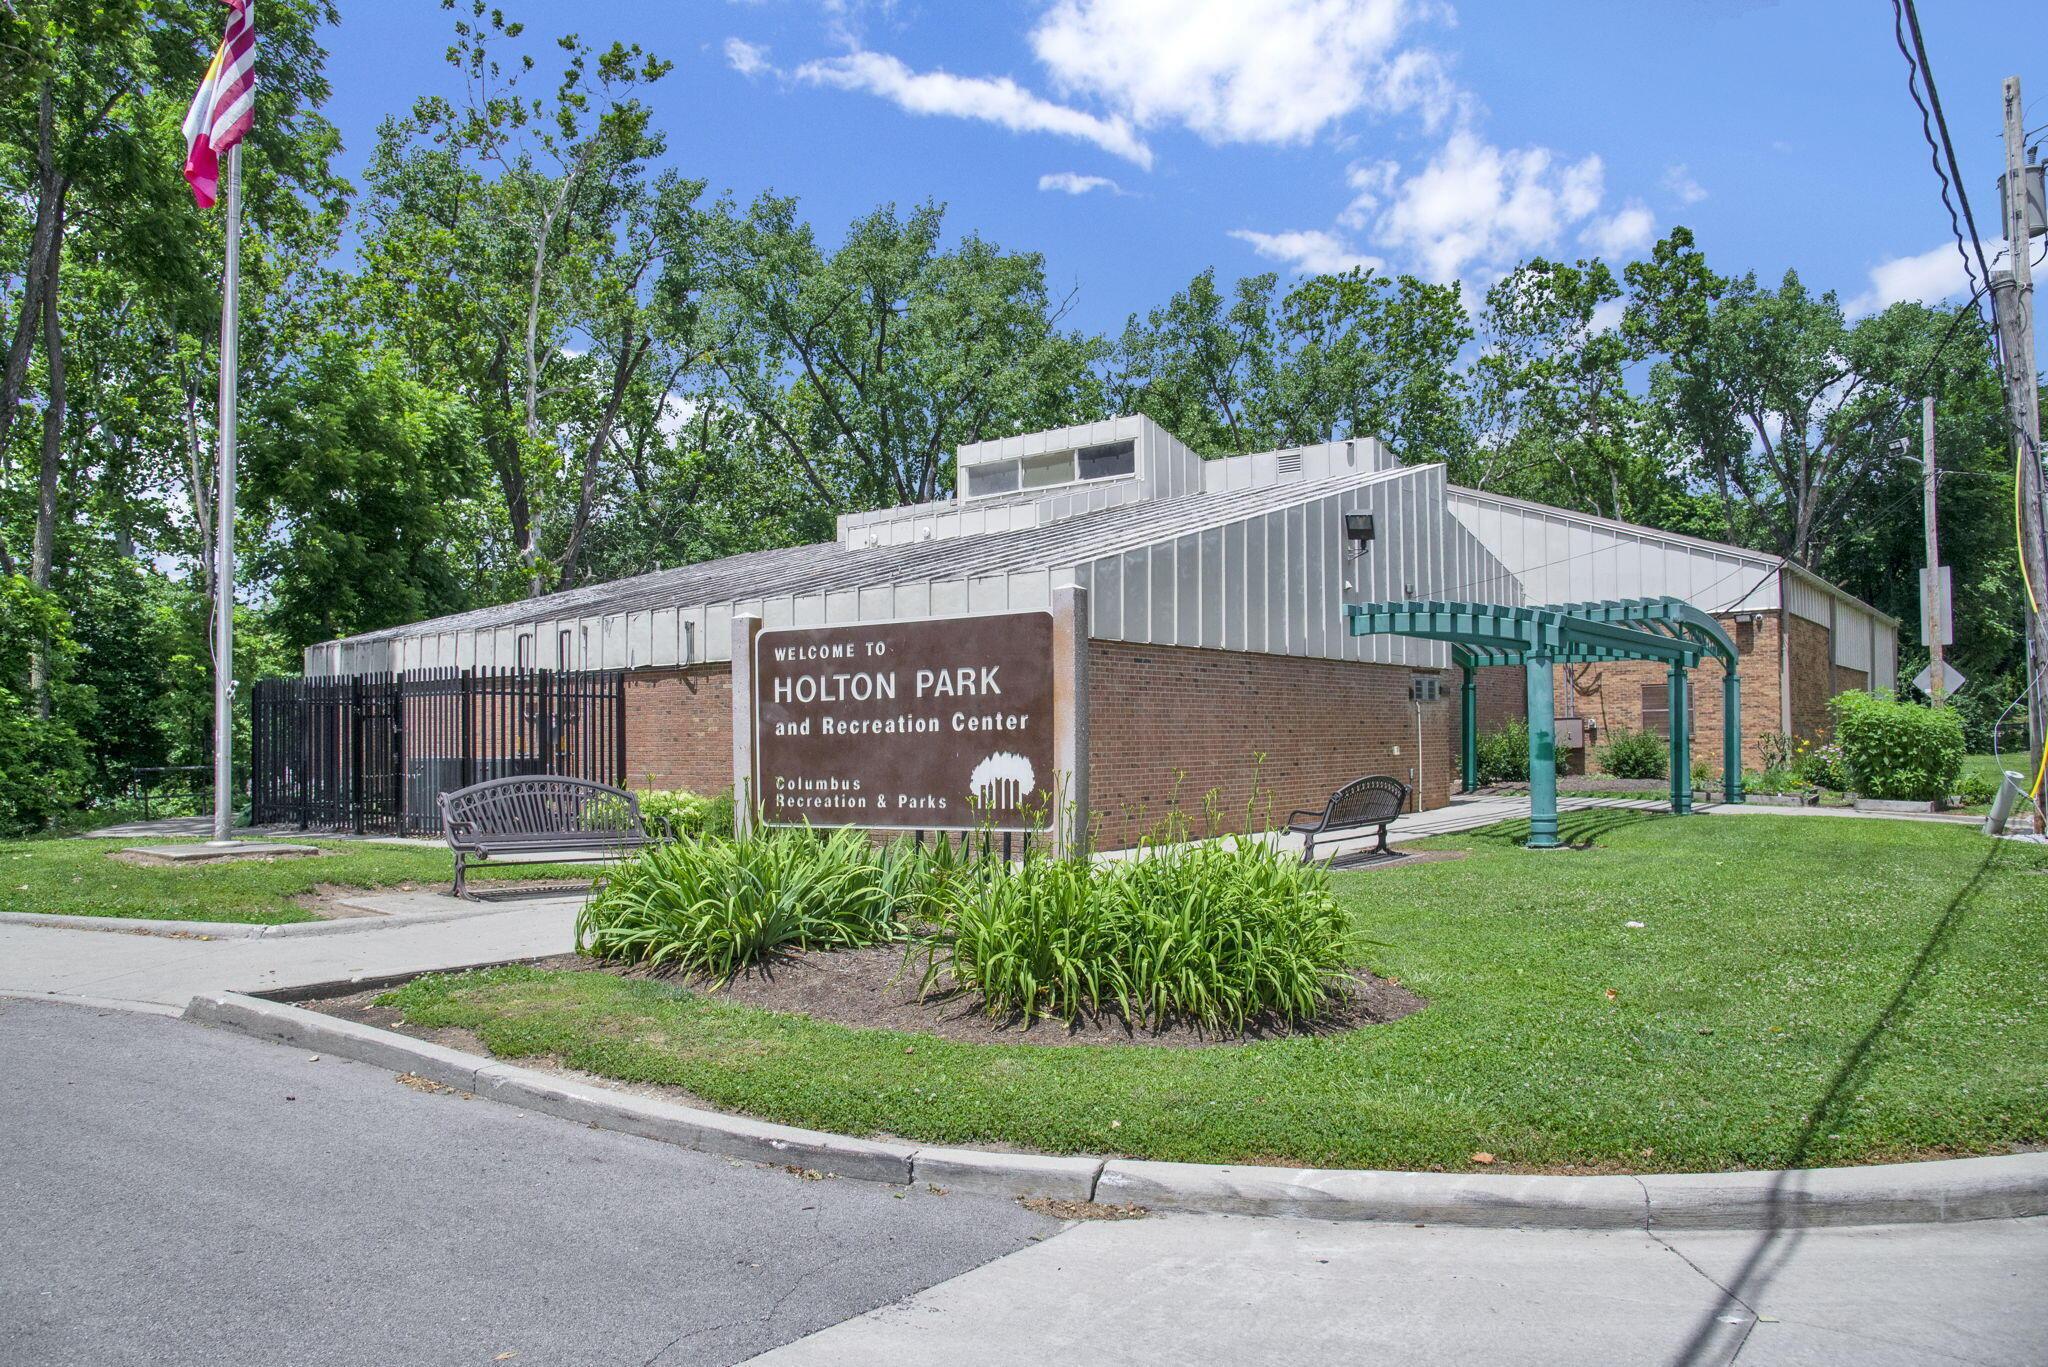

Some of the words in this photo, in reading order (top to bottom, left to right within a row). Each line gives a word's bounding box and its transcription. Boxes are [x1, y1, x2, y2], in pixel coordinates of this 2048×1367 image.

[774, 643, 855, 662] WELCOME
[866, 641, 886, 656] TO
[774, 671, 896, 703] HOLTON
[916, 665, 1001, 698] PARK
[775, 717, 810, 736] and
[822, 713, 940, 735] Recreation
[952, 711, 1029, 732] Center
[775, 776, 861, 791] Columbus
[775, 794, 867, 809] Recreation
[877, 795, 887, 808] &
[898, 795, 947, 809] Parks
